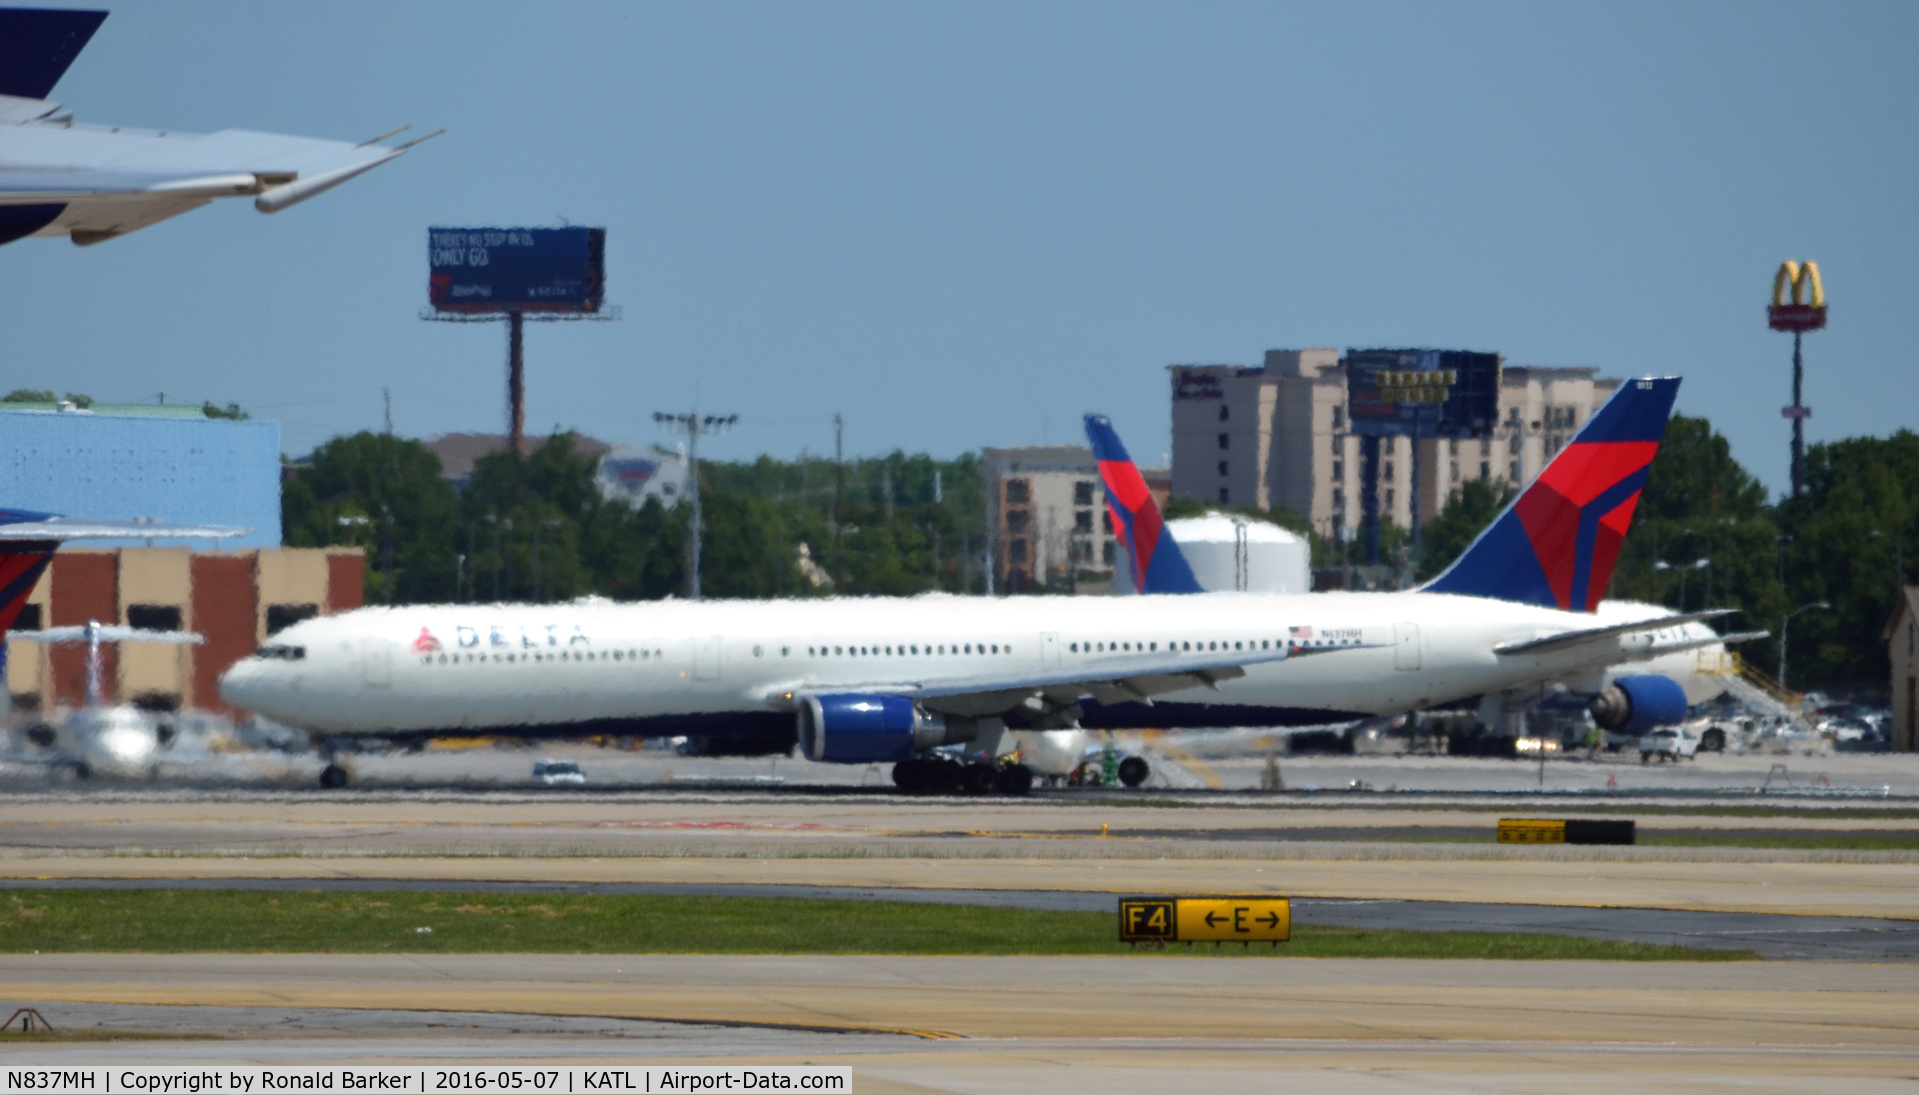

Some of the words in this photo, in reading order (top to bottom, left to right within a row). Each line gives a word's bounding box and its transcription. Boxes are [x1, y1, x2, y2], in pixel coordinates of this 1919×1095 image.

[432, 248, 466, 267] ONLY
[456, 624, 589, 649] DELTA
[1128, 906, 1168, 934] F4
[1234, 907, 1250, 933] E
